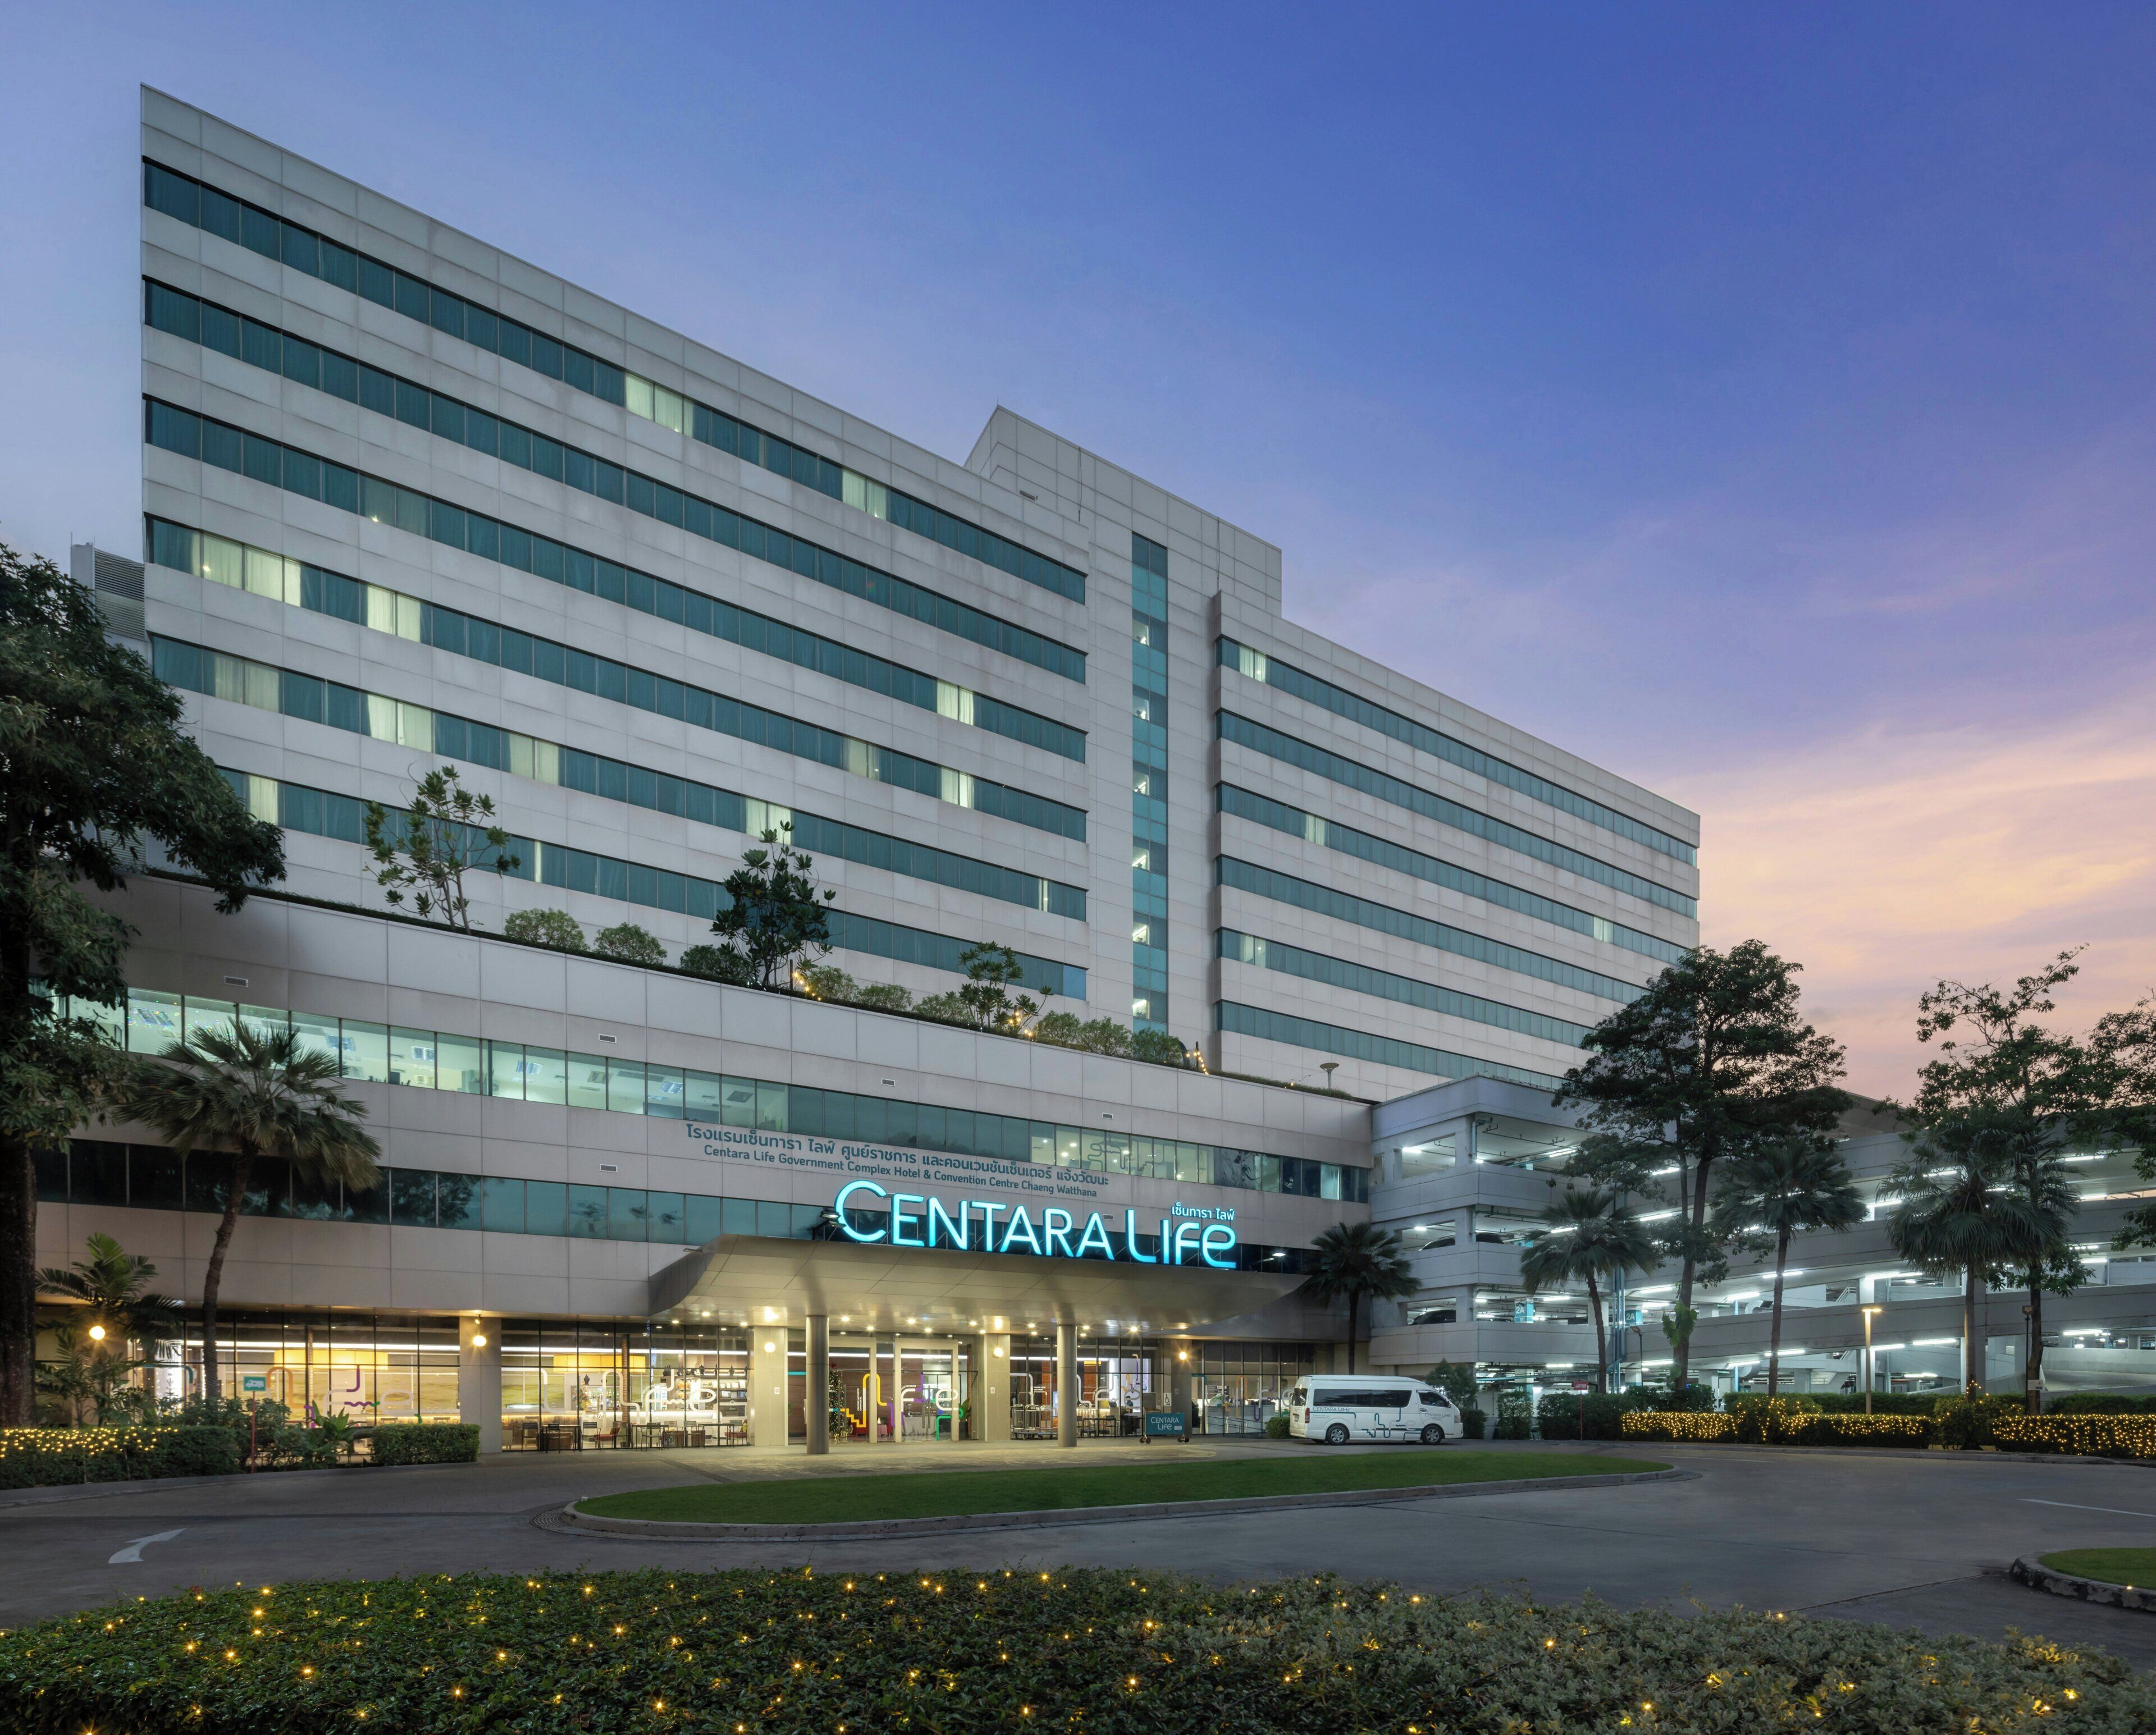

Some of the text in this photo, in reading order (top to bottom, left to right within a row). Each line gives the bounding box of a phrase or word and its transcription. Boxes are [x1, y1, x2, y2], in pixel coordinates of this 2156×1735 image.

[686, 1123, 802, 1150] โรงแรมเซ็นทารา
[808, 1138, 835, 1155] ไลฟ์
[842, 1145, 917, 1164] ศูนย์ราชการ
[1057, 1168, 1109, 1185] แจ้งวัฒนะ
[704, 1145, 1097, 1197] Centara Life Government Complex Hotel & Convention Centre Chaeng Watthana
[834, 1179, 1115, 1261] CENTARA
[1171, 1202, 1235, 1221] เซ็นทารา ไลฟ์
